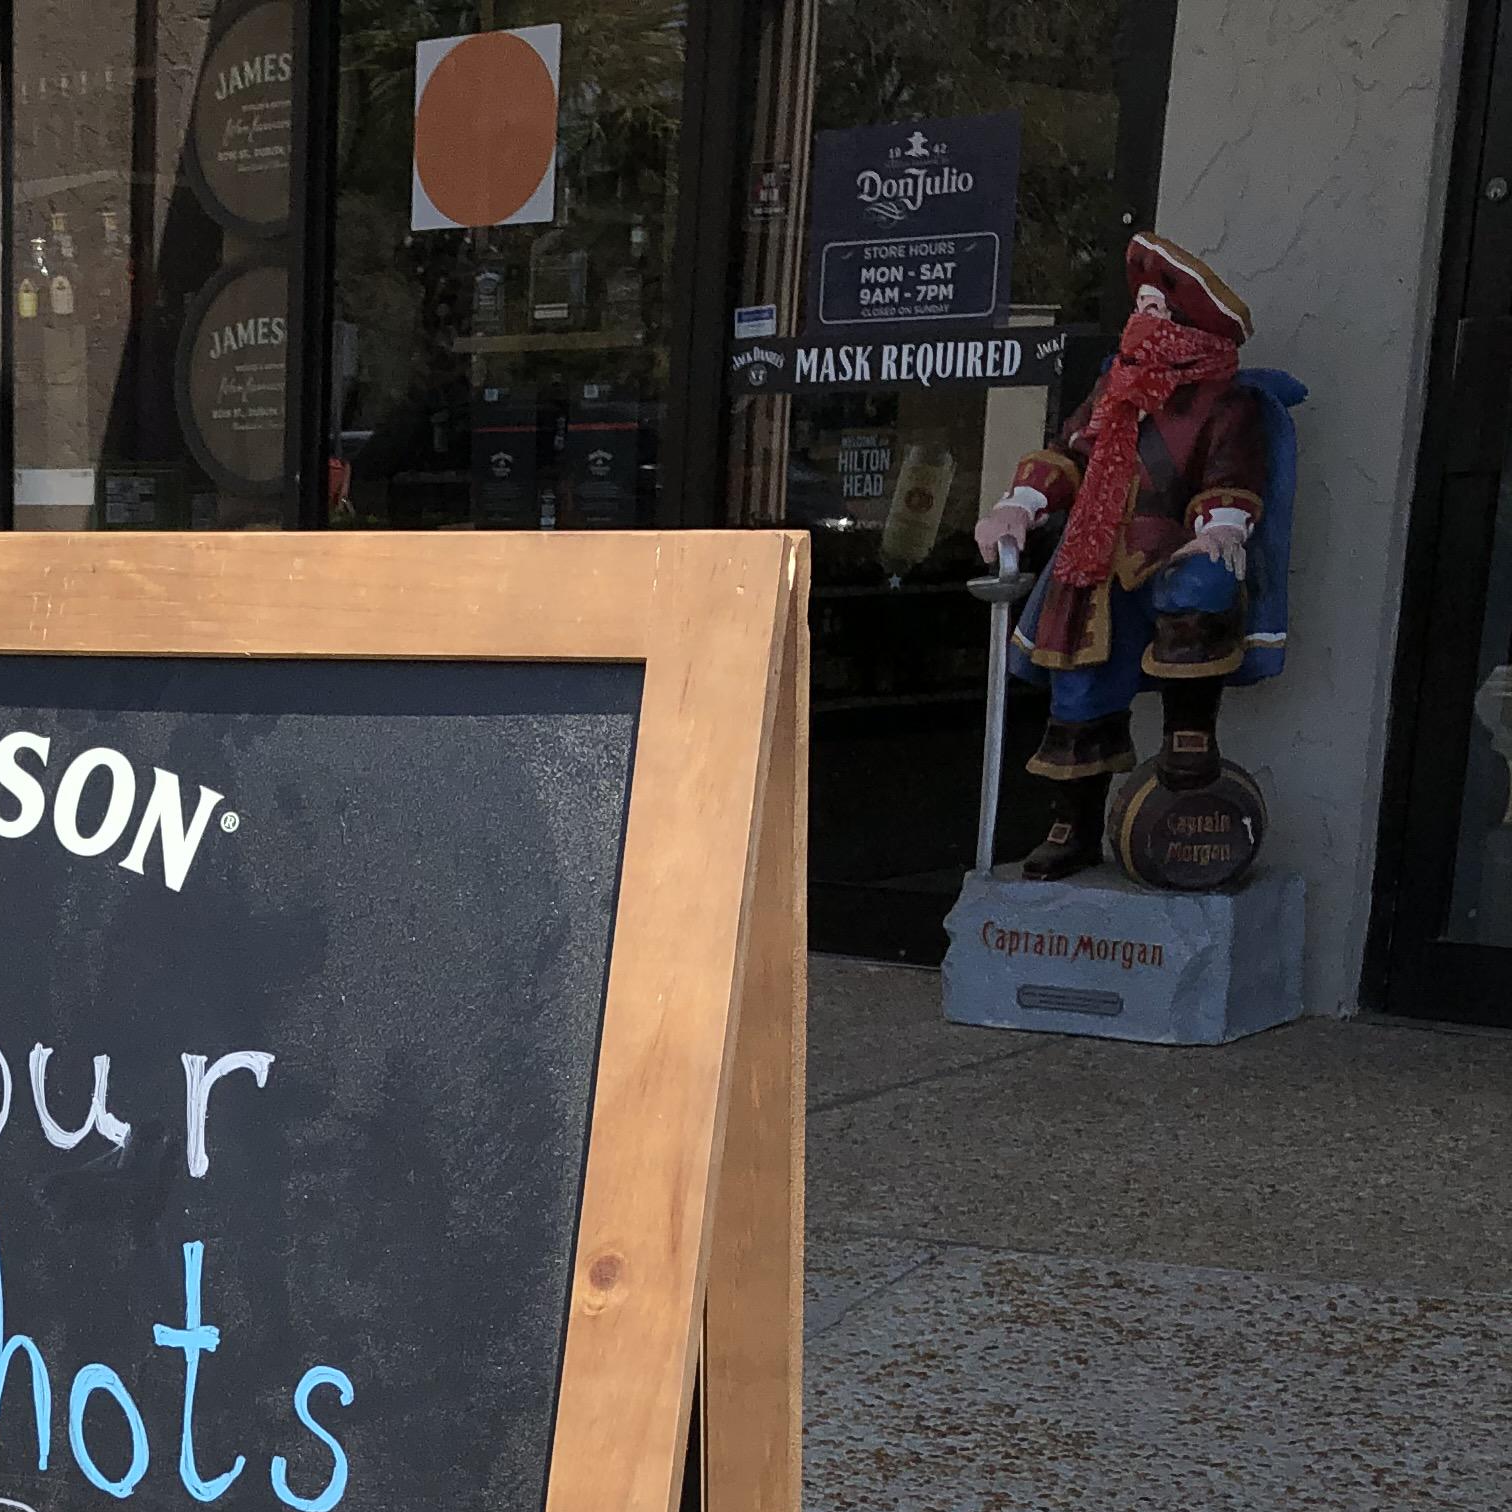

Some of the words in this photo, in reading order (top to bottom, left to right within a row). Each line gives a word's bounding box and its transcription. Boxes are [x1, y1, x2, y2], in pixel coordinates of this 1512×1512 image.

[864, 245, 905, 260] STORE
[908, 241, 955, 256] HOURS
[861, 265, 904, 284] MON
[920, 262, 956, 281] SAT
[859, 286, 899, 305] 9AM
[916, 284, 954, 301] 7PM
[794, 345, 872, 383] MASK
[880, 340, 1022, 387] REQUIRED
[839, 448, 890, 472] HILTON
[843, 473, 884, 497] HEAD
[982, 920, 1068, 957] Captain
[1070, 933, 1163, 969] Morgan
